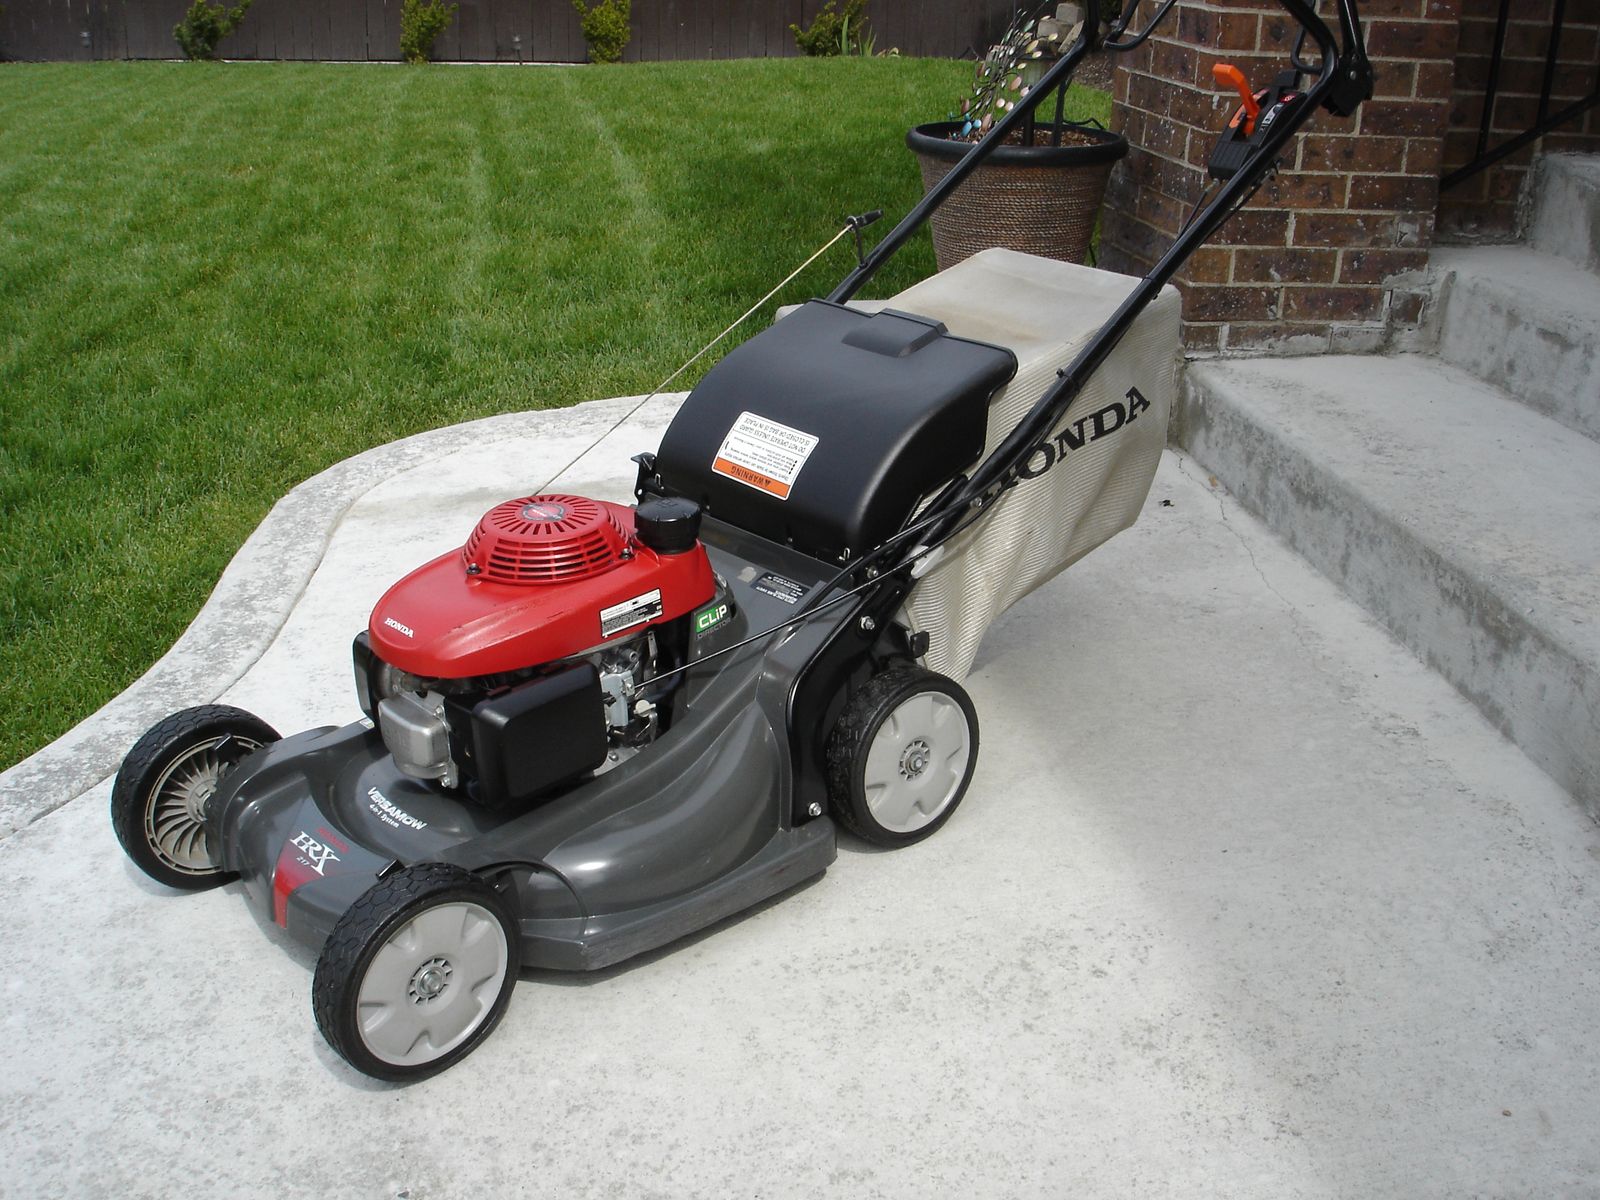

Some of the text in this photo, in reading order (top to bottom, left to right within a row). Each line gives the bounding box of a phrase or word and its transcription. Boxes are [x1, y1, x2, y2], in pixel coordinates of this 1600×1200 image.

[731, 466, 765, 485] WARNING
[384, 617, 414, 639] HONDA
[368, 786, 428, 830] VERSAMOW
[381, 813, 400, 829] System
[290, 831, 341, 876] HRX
